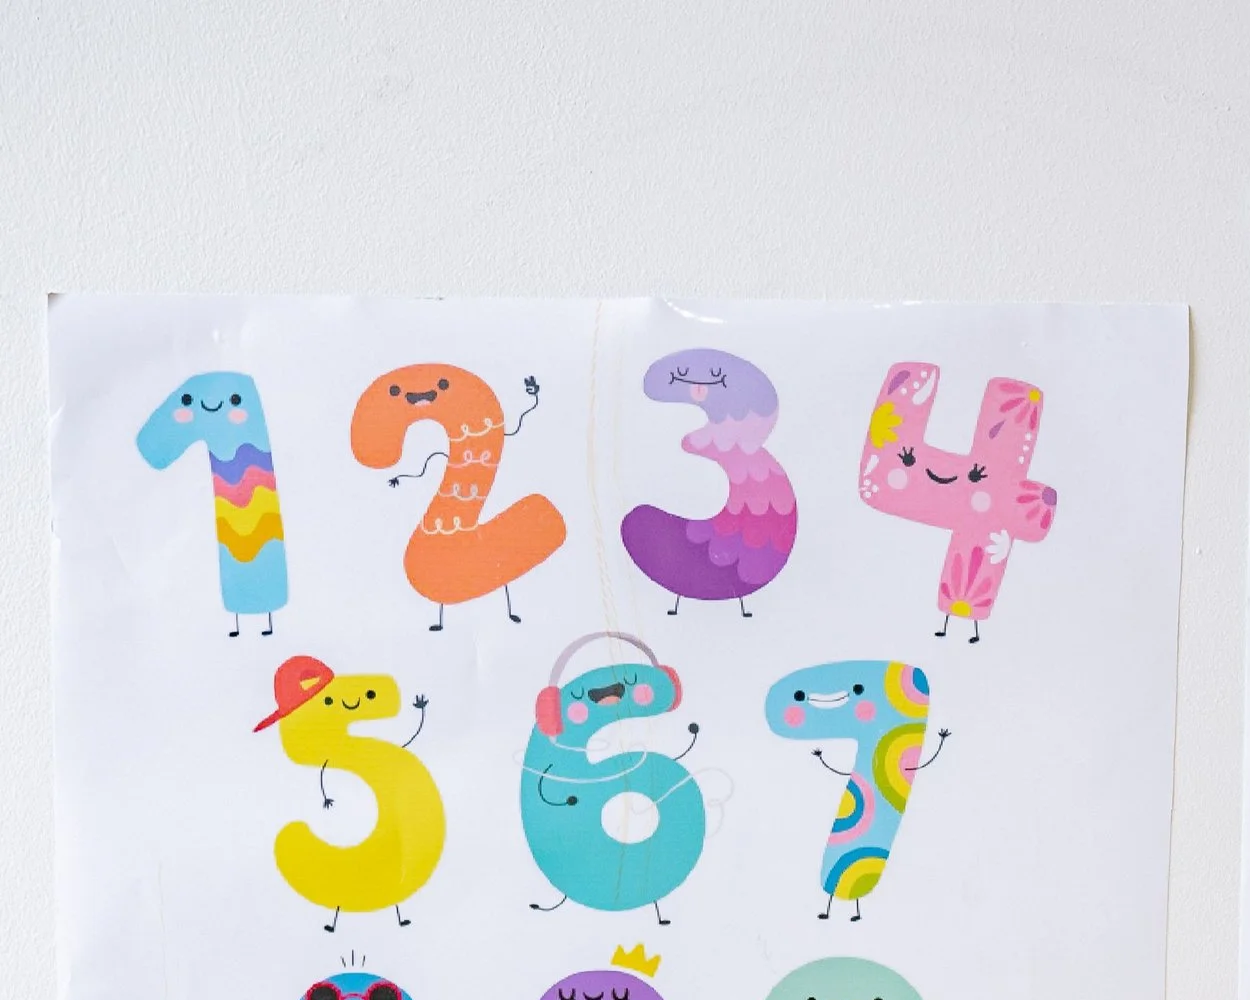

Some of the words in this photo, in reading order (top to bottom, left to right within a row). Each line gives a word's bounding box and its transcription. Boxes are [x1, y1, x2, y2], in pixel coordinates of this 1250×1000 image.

[136, 371, 289, 614] 1
[350, 363, 567, 605] 2
[620, 348, 798, 600] 3
[859, 362, 1057, 620] 4
[274, 674, 447, 913] 5
[520, 663, 705, 911] 6
[765, 660, 930, 901] 7
